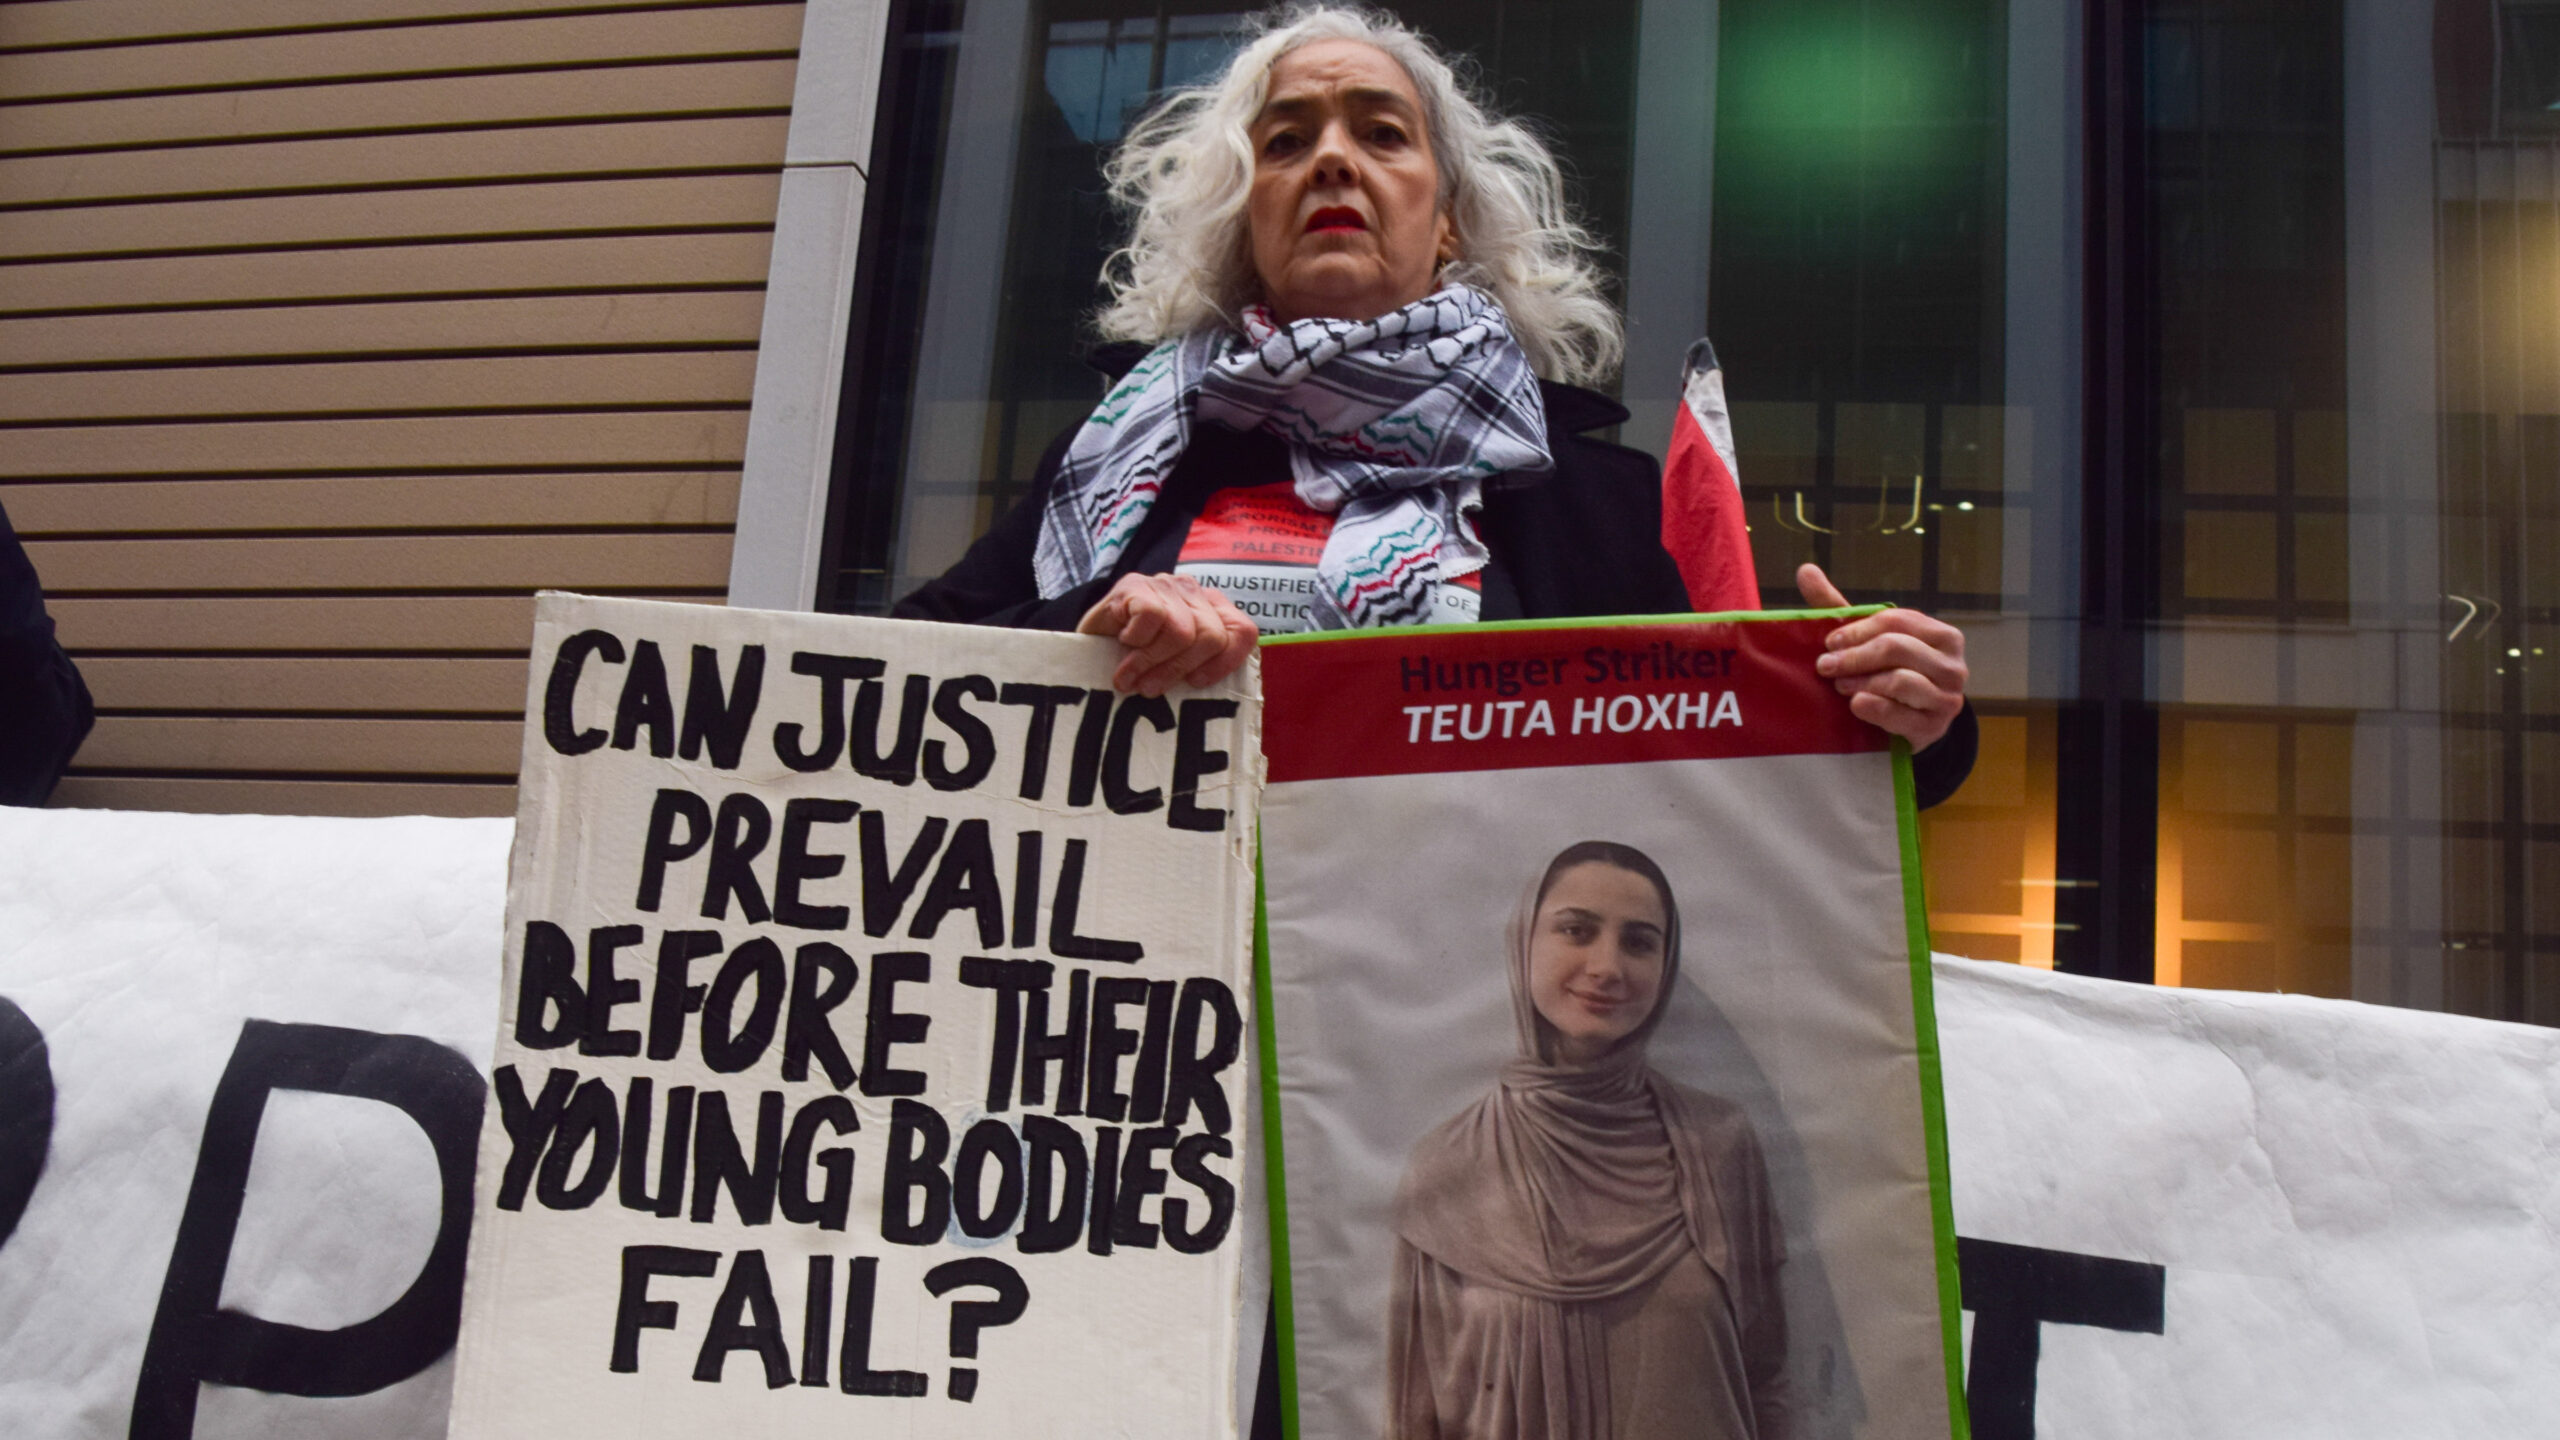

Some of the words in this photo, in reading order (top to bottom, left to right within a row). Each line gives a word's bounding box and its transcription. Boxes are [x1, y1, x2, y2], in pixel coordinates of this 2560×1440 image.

[1401, 654, 1569, 697] Hunger
[1584, 641, 1738, 684] Striker
[1446, 595, 1472, 610] OF
[544, 629, 765, 770] CAN
[773, 652, 1240, 832] JUSTICE
[1402, 700, 1556, 744] TEUTA
[1570, 691, 1744, 736] HOXHA
[636, 789, 1144, 964] PREVAIL
[515, 921, 931, 1097] BEFORE
[959, 956, 1243, 1135] THEIR
[494, 1064, 861, 1231] YOUNG
[881, 1098, 1241, 1256] BODIES
[610, 1245, 1031, 1402] FAIL?
